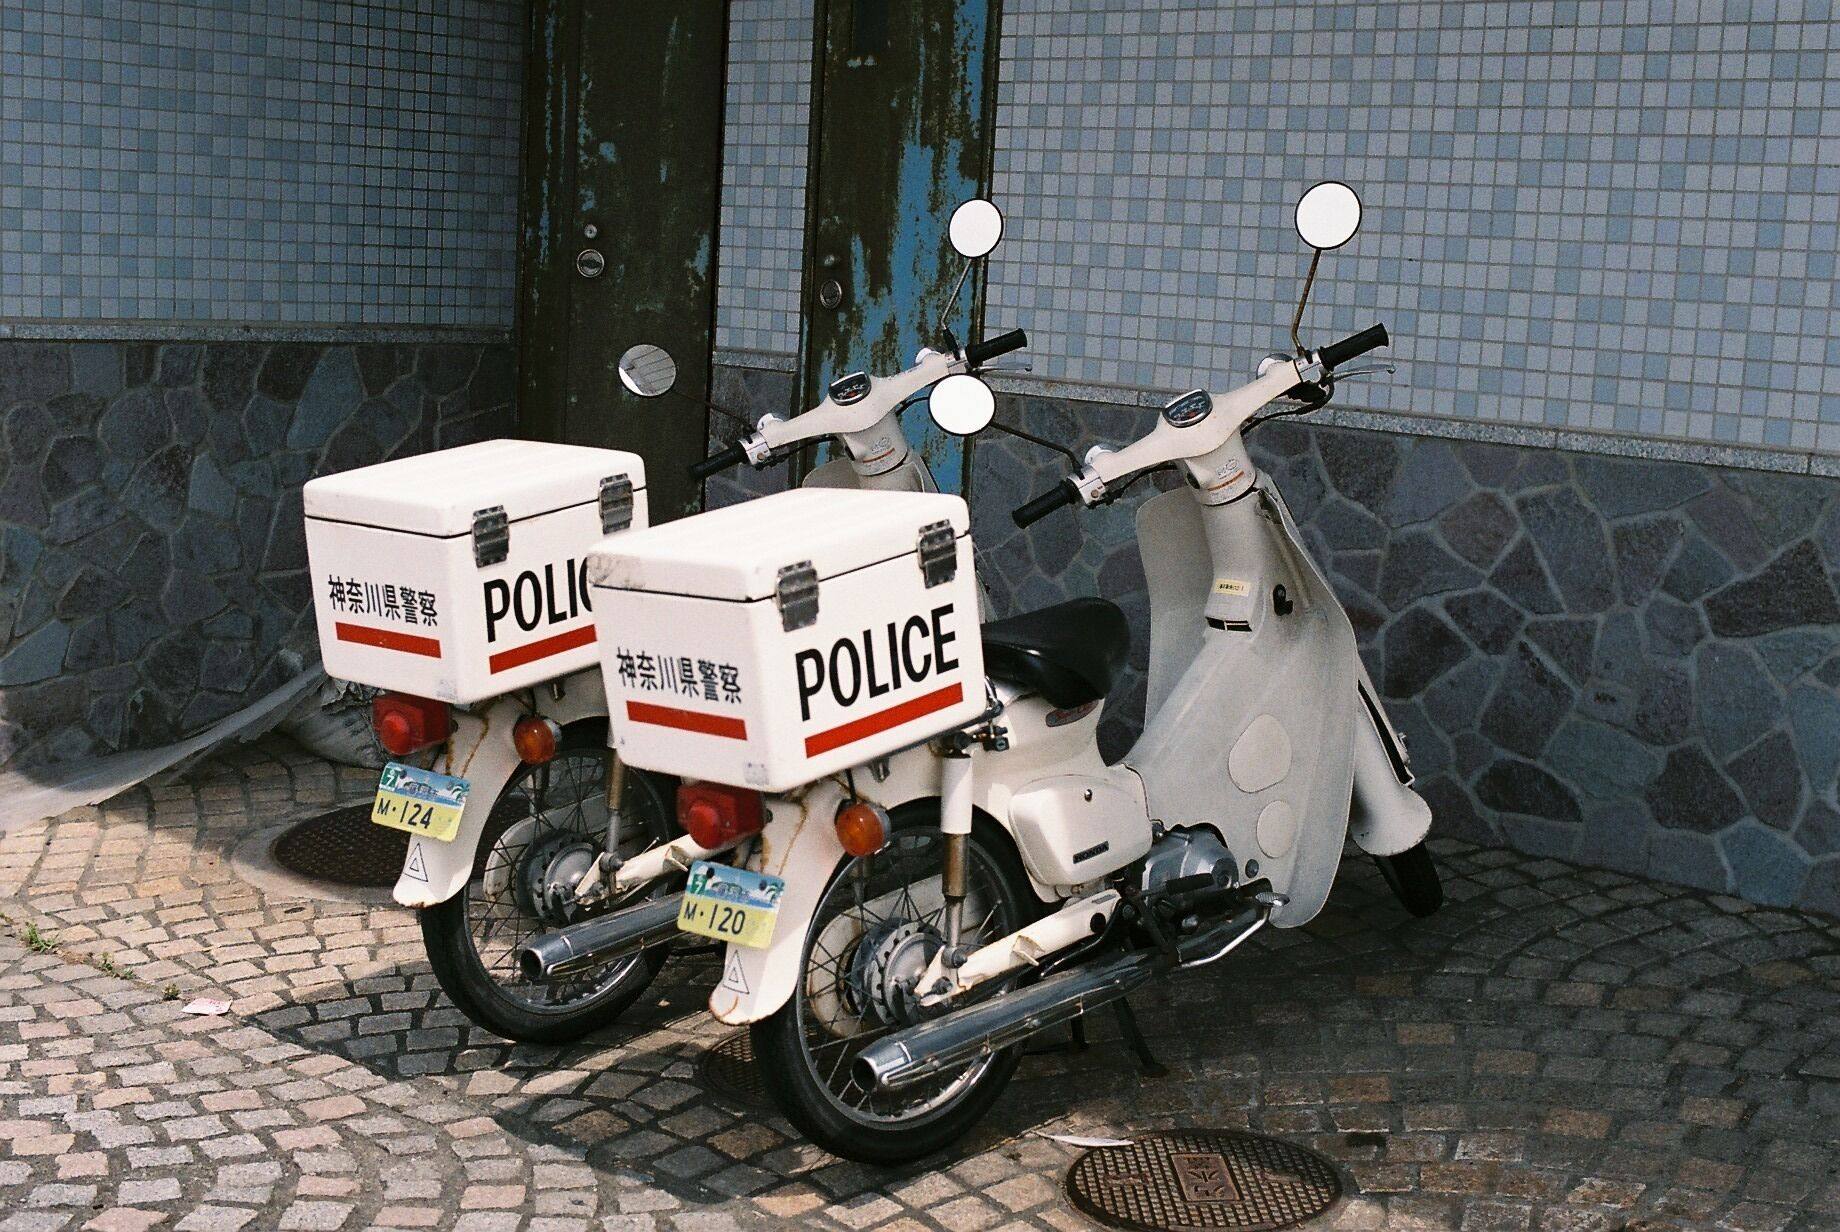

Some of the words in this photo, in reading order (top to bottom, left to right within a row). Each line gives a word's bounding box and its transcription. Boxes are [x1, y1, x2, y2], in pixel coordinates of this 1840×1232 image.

[328, 574, 438, 627] 神奈川県警察
[616, 646, 742, 704] 神奈川県警察
[795, 603, 960, 721] POLICE
